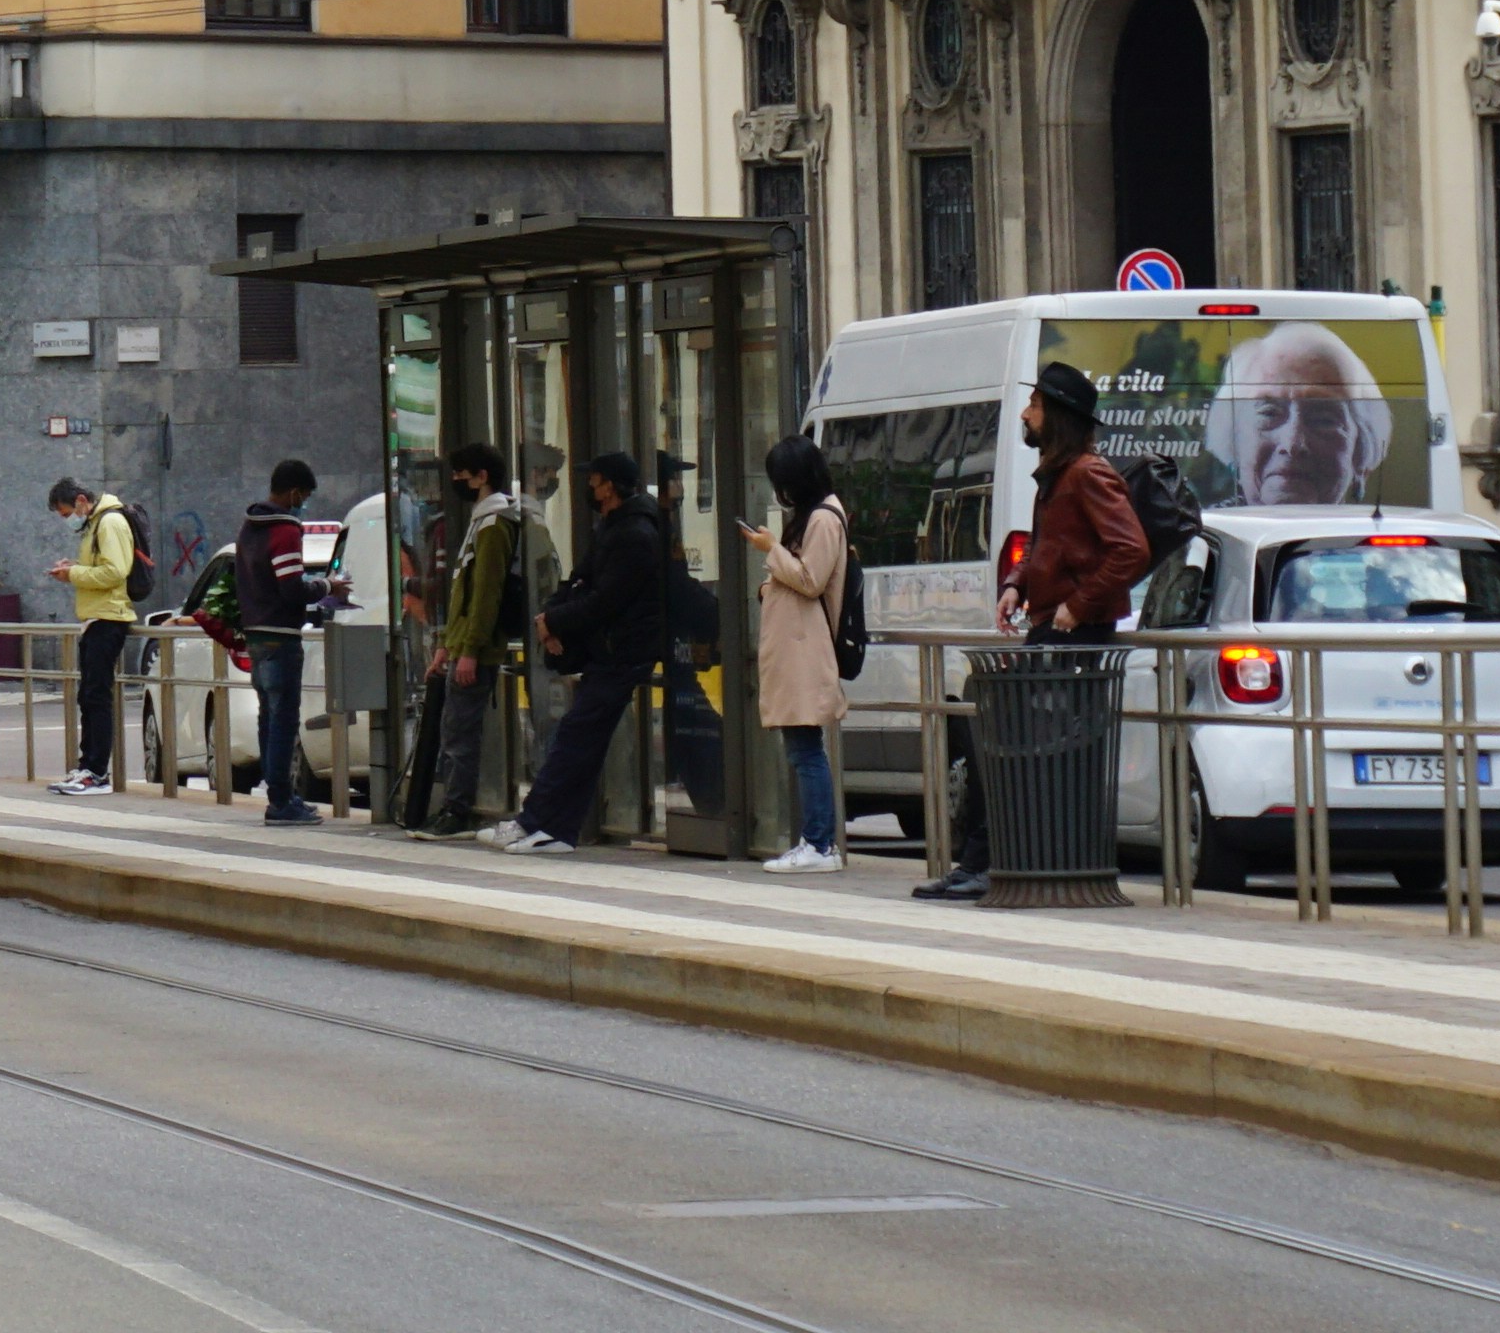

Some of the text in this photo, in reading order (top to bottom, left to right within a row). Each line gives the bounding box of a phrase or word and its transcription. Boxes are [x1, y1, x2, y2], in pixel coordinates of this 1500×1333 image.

[1117, 368, 1165, 392] vita
[1100, 408, 1146, 426] una
[1094, 433, 1201, 457] ellissima
[303, 524, 339, 533] TAXI
[1371, 757, 1397, 780] FY
